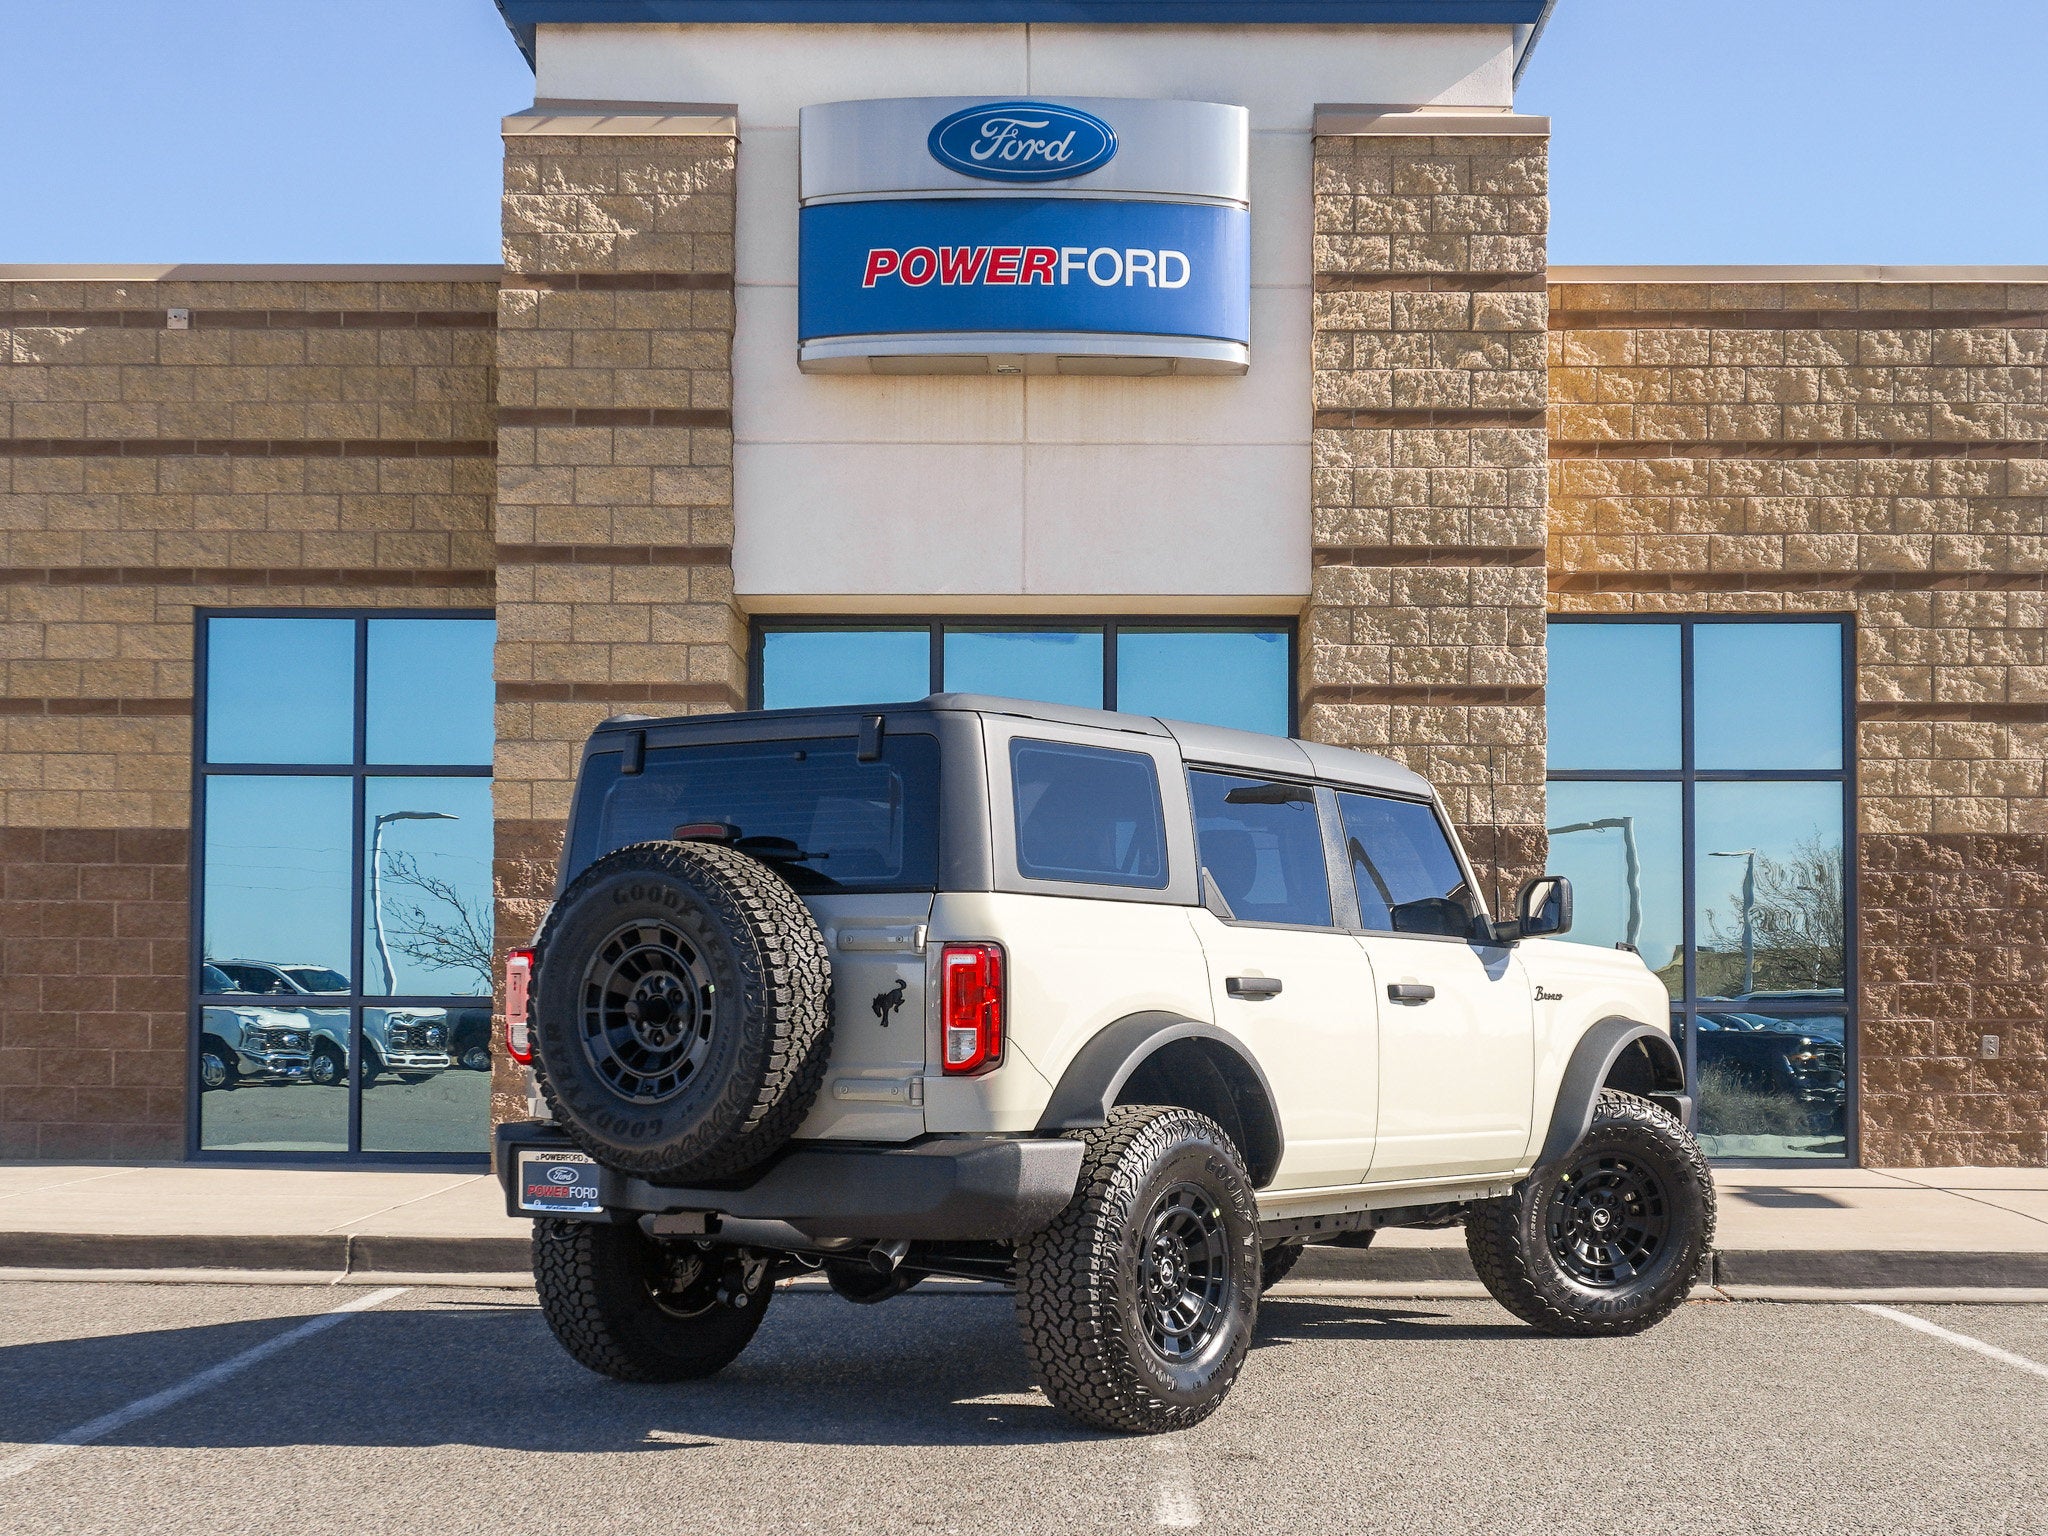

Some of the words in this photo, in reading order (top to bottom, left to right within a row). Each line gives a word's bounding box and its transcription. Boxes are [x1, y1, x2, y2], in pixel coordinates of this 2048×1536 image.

[970, 118, 1076, 163] Ford
[1534, 985, 1563, 1001] Bronco
[540, 1153, 584, 1162] POWERFORD
[553, 1168, 573, 1180] Ford
[527, 1185, 598, 1199] POWERFORD
